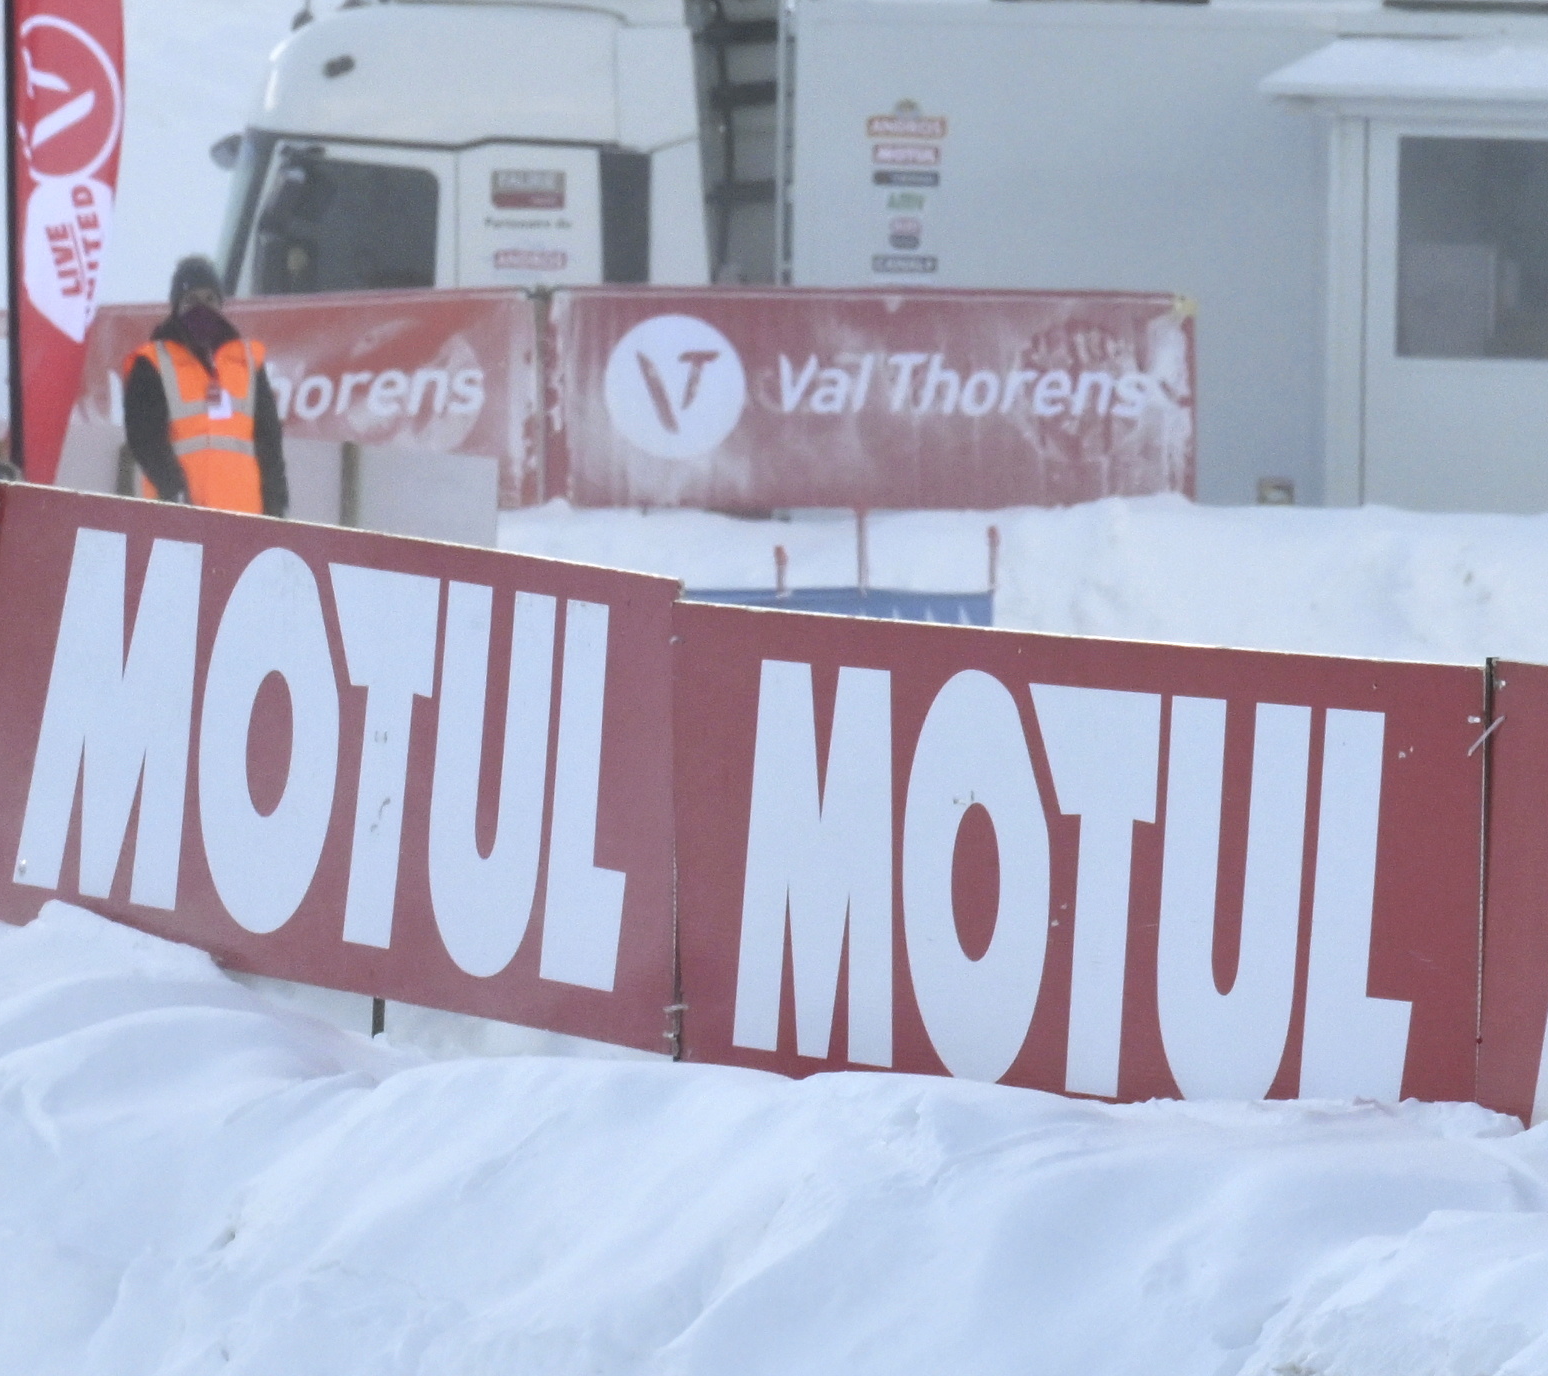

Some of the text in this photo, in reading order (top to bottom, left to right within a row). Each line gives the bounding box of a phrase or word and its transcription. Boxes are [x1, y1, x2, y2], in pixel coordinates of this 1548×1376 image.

[45, 222, 84, 298] LIVE
[267, 361, 486, 421] horens
[778, 353, 875, 414] Val
[887, 351, 1151, 418] Thorens
[12, 526, 628, 993] MOTUL
[732, 658, 1413, 1102] MOTUL
